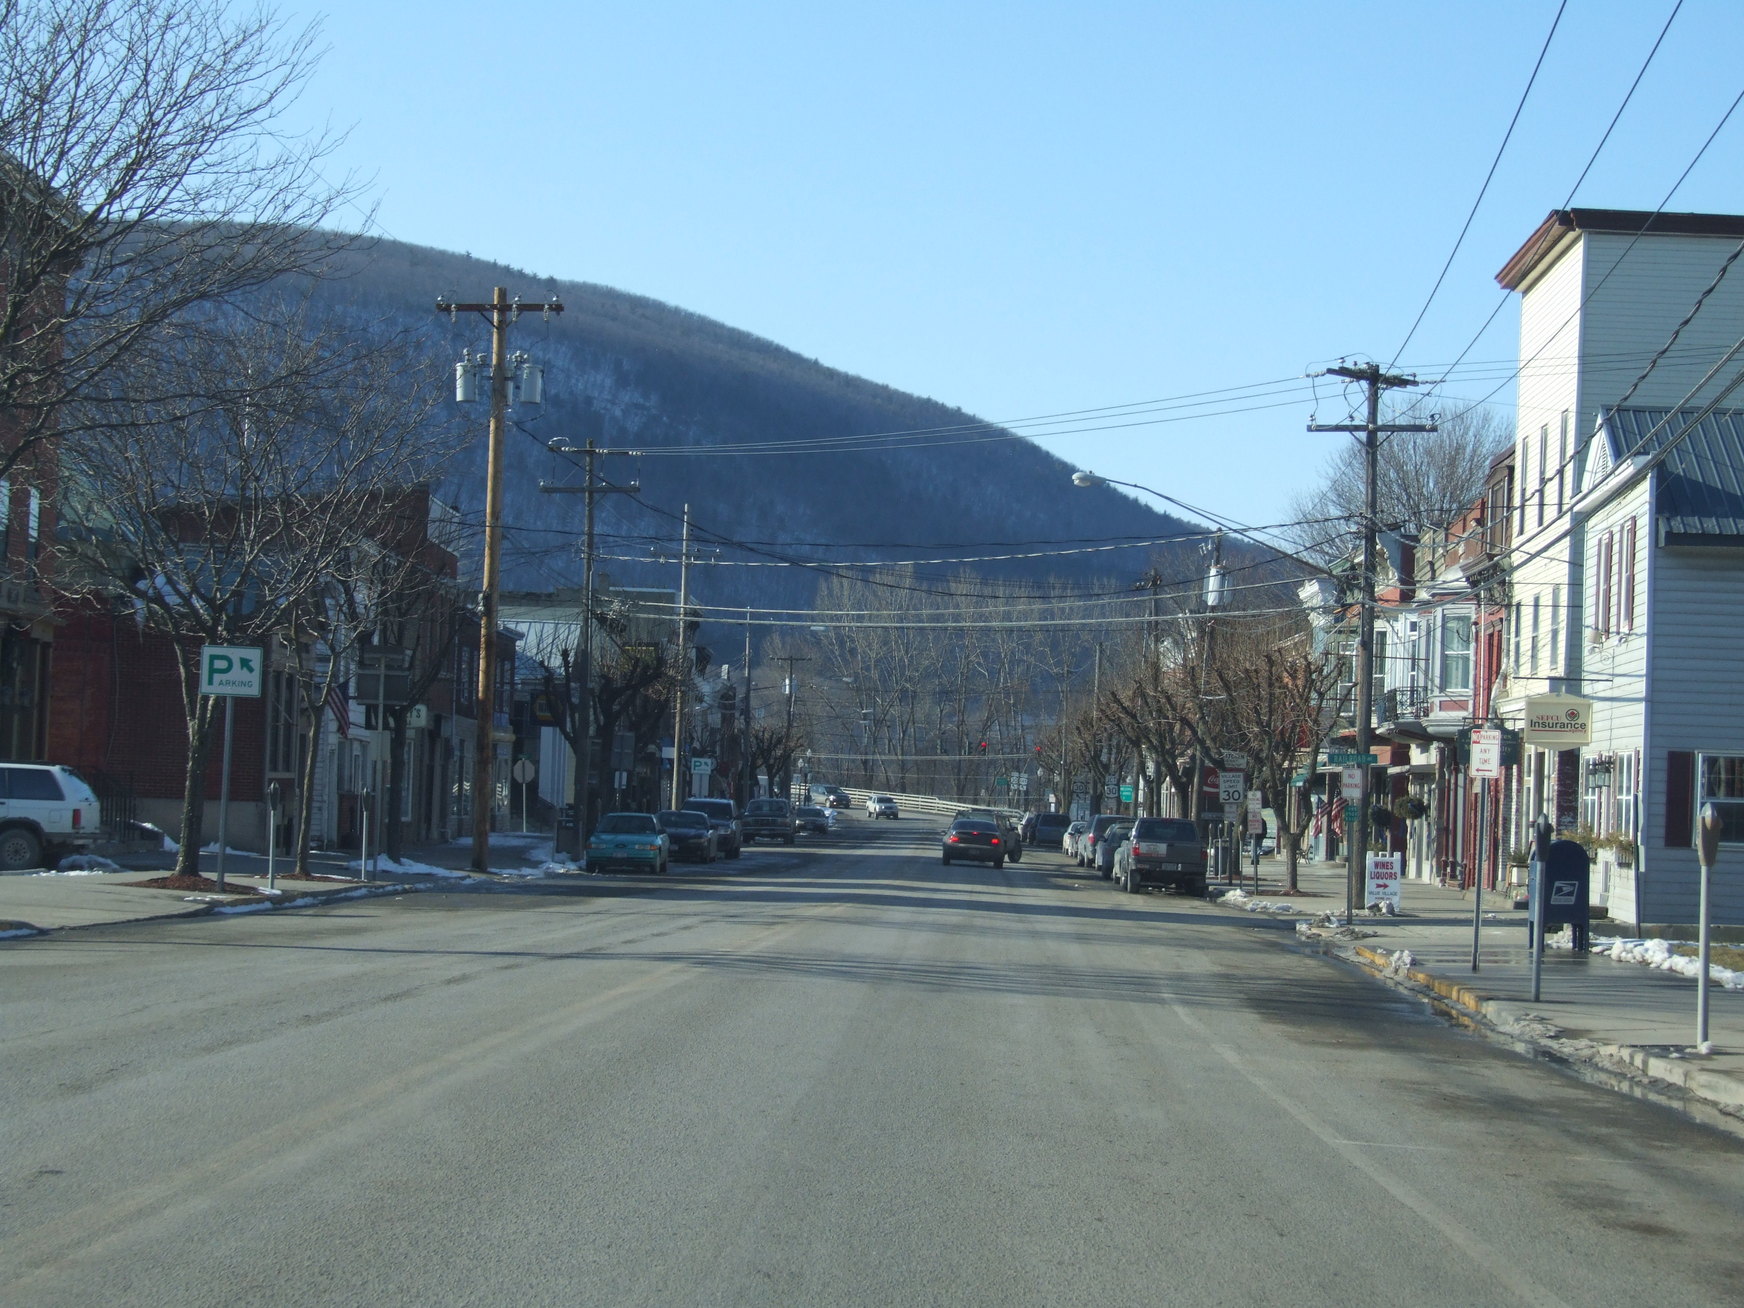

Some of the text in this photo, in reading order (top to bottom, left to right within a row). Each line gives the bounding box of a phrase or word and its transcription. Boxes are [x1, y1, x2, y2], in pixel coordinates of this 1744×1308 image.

[1530, 719, 1587, 730] Insurance
[1480, 757, 1491, 765] TIME
[1106, 787, 1117, 795] 30
[1222, 789, 1241, 801] 30
[1373, 861, 1394, 870] WINES
[1370, 871, 1398, 880] LIQUORS
